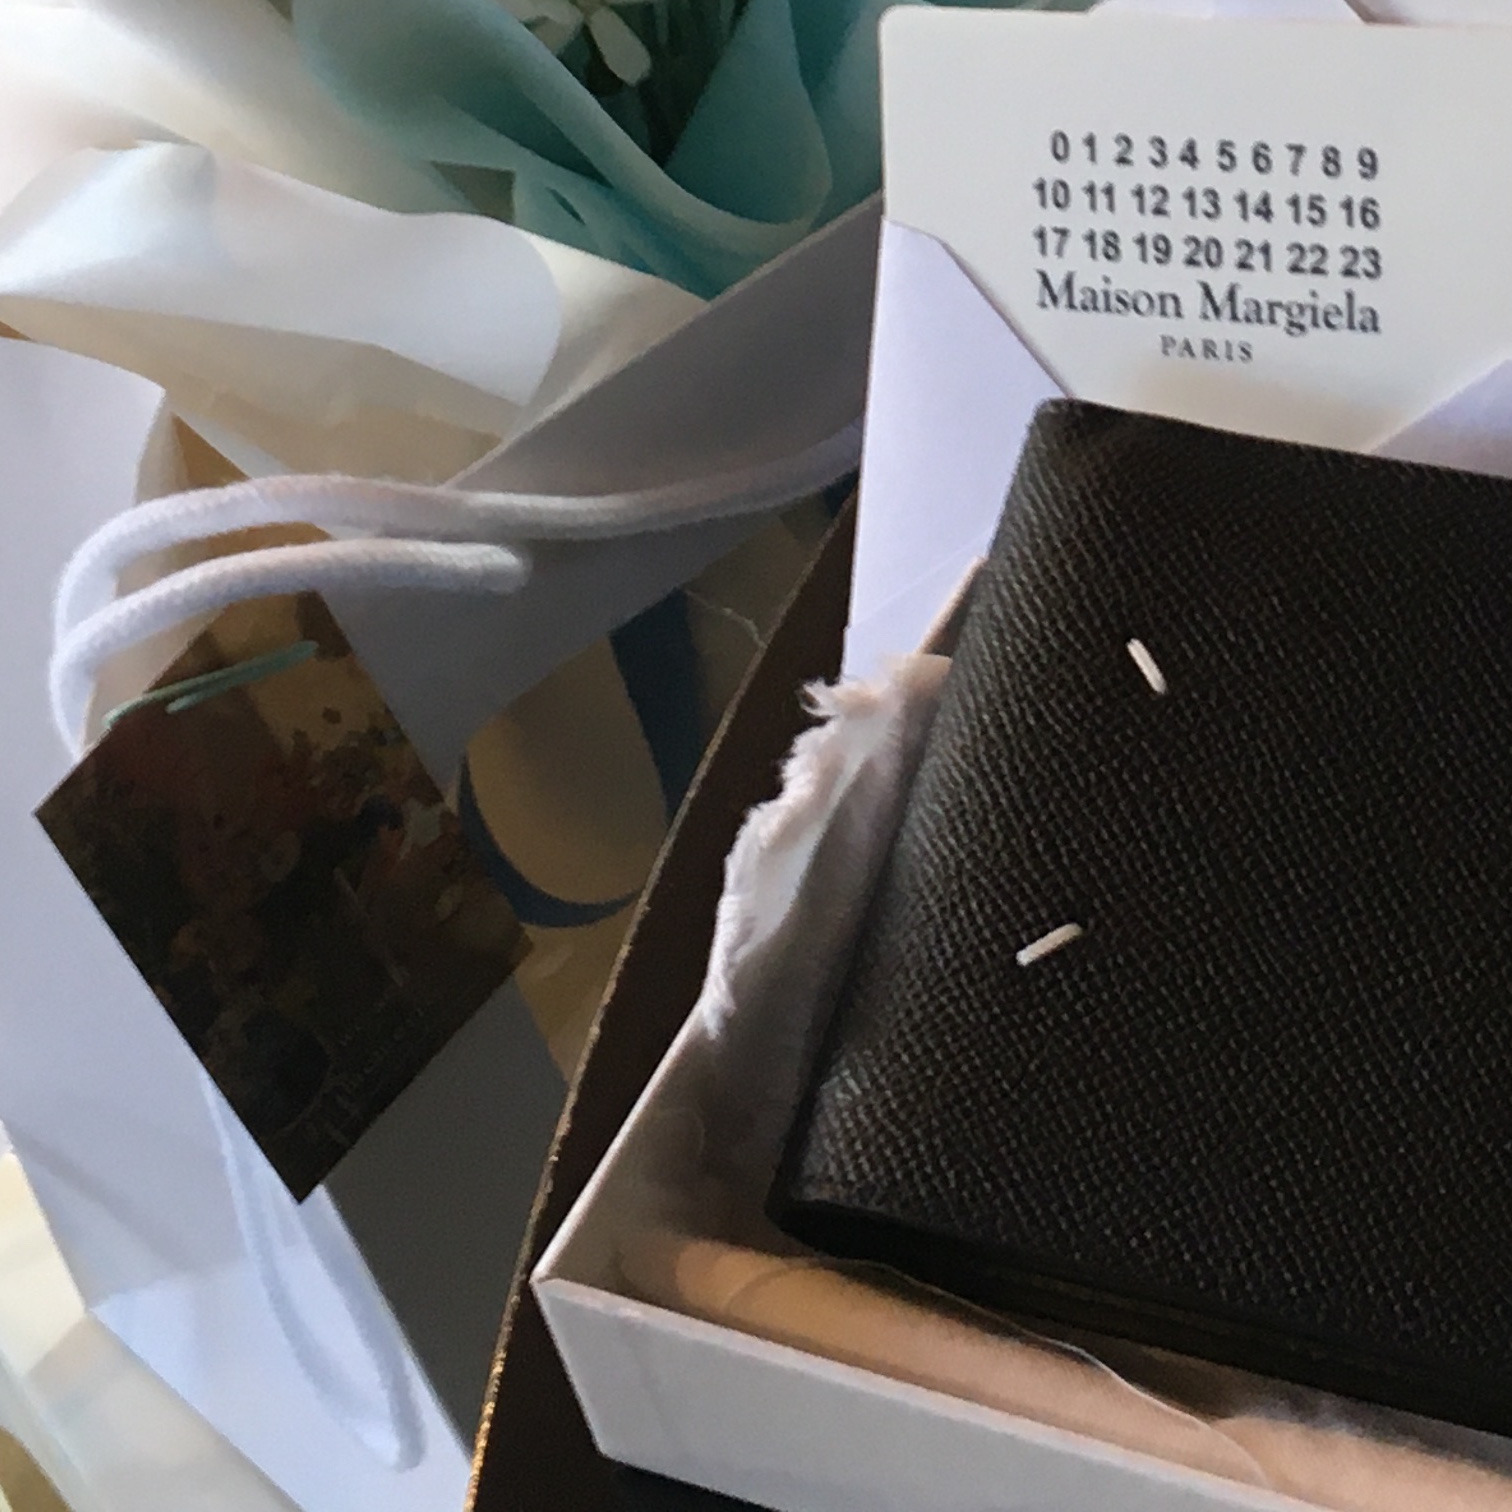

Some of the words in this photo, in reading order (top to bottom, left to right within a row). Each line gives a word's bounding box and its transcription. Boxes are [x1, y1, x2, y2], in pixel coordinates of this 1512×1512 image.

[1050, 129, 1071, 164] 0
[1082, 132, 1097, 165] 1
[1114, 134, 1134, 167] 2
[1148, 136, 1168, 169] 3
[1179, 138, 1199, 170] 4
[1217, 140, 1237, 172] 5
[1252, 141, 1273, 174] 6
[1285, 144, 1307, 176] 7
[1321, 145, 1341, 178] 8
[1358, 147, 1379, 181] 9
[1033, 177, 1071, 211] 10
[1082, 181, 1116, 214] 11
[1131, 183, 1171, 217] 12
[1183, 186, 1221, 220] 13
[1234, 189, 1273, 223] 14
[1286, 193, 1327, 227] 15
[1339, 196, 1381, 230] 16
[1033, 226, 1071, 259] 17
[1082, 229, 1122, 262] 18
[1133, 232, 1172, 266] 19
[1183, 236, 1223, 268] 20
[1235, 238, 1273, 272] 21
[1286, 242, 1330, 276] 22
[1339, 246, 1382, 279] 23
[1035, 269, 1184, 319] Maison
[1197, 280, 1382, 337] Margiela
[1160, 335, 1254, 362] PARIS
